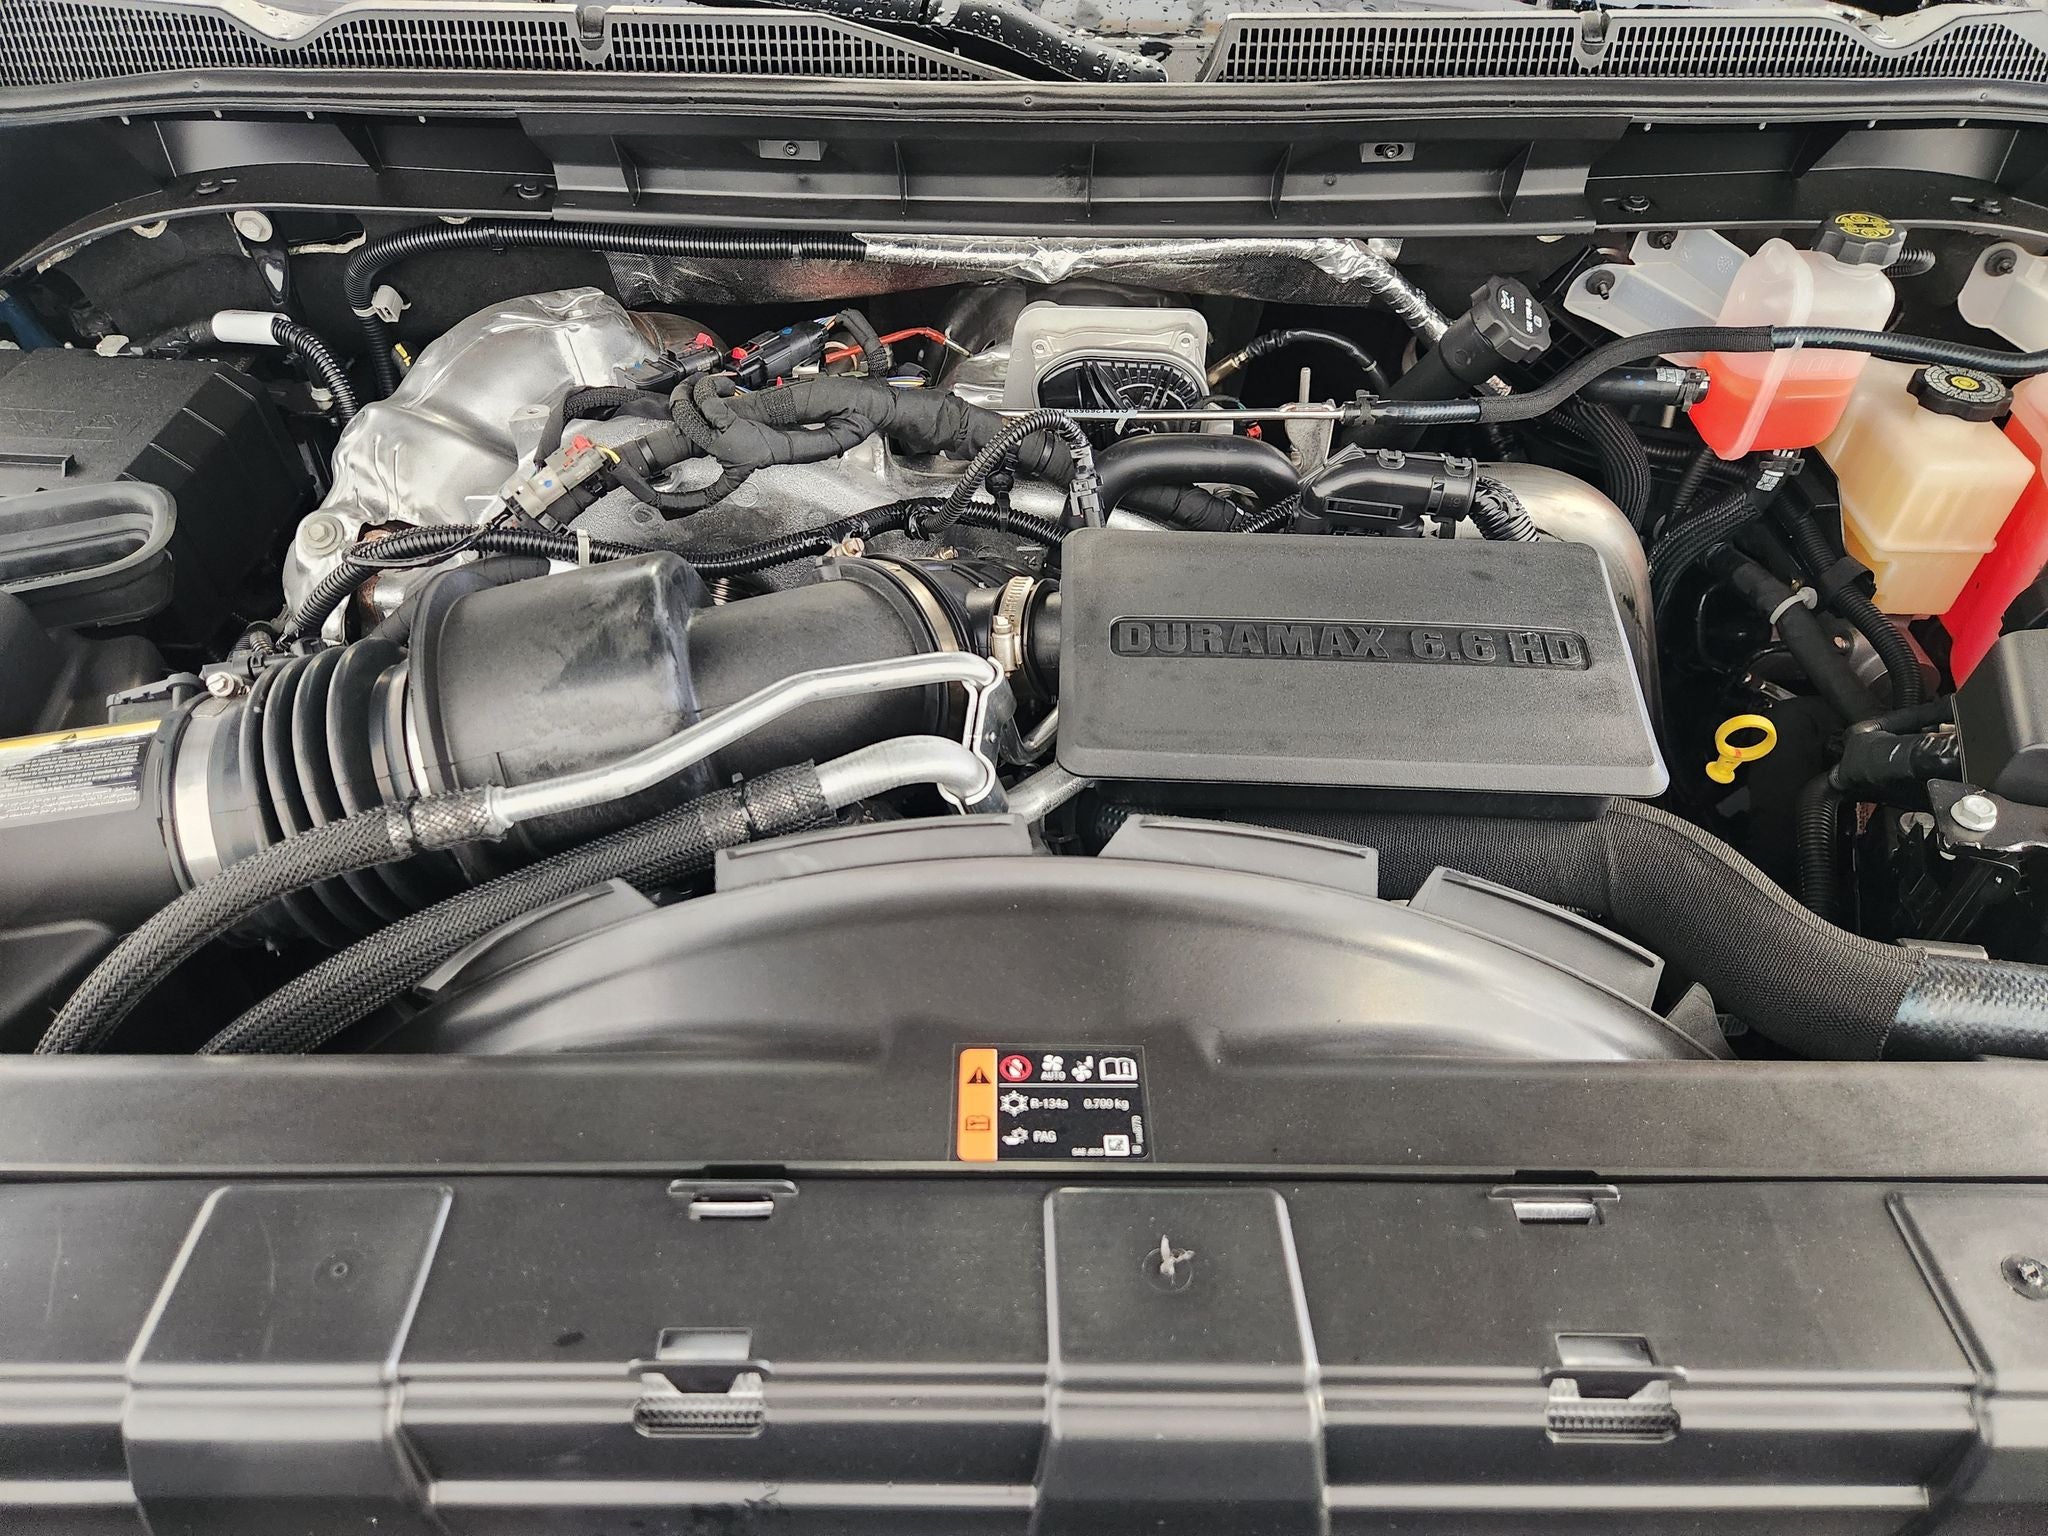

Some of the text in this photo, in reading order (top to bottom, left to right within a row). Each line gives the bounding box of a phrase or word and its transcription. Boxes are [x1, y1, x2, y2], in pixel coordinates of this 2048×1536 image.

[1117, 621, 1584, 667] DURAMAX 6.6 HD
[1040, 1071, 1066, 1082] AUTO
[1029, 1098, 1130, 1112] R-134a 0.700 kg
[1032, 1130, 1058, 1143] PAG
